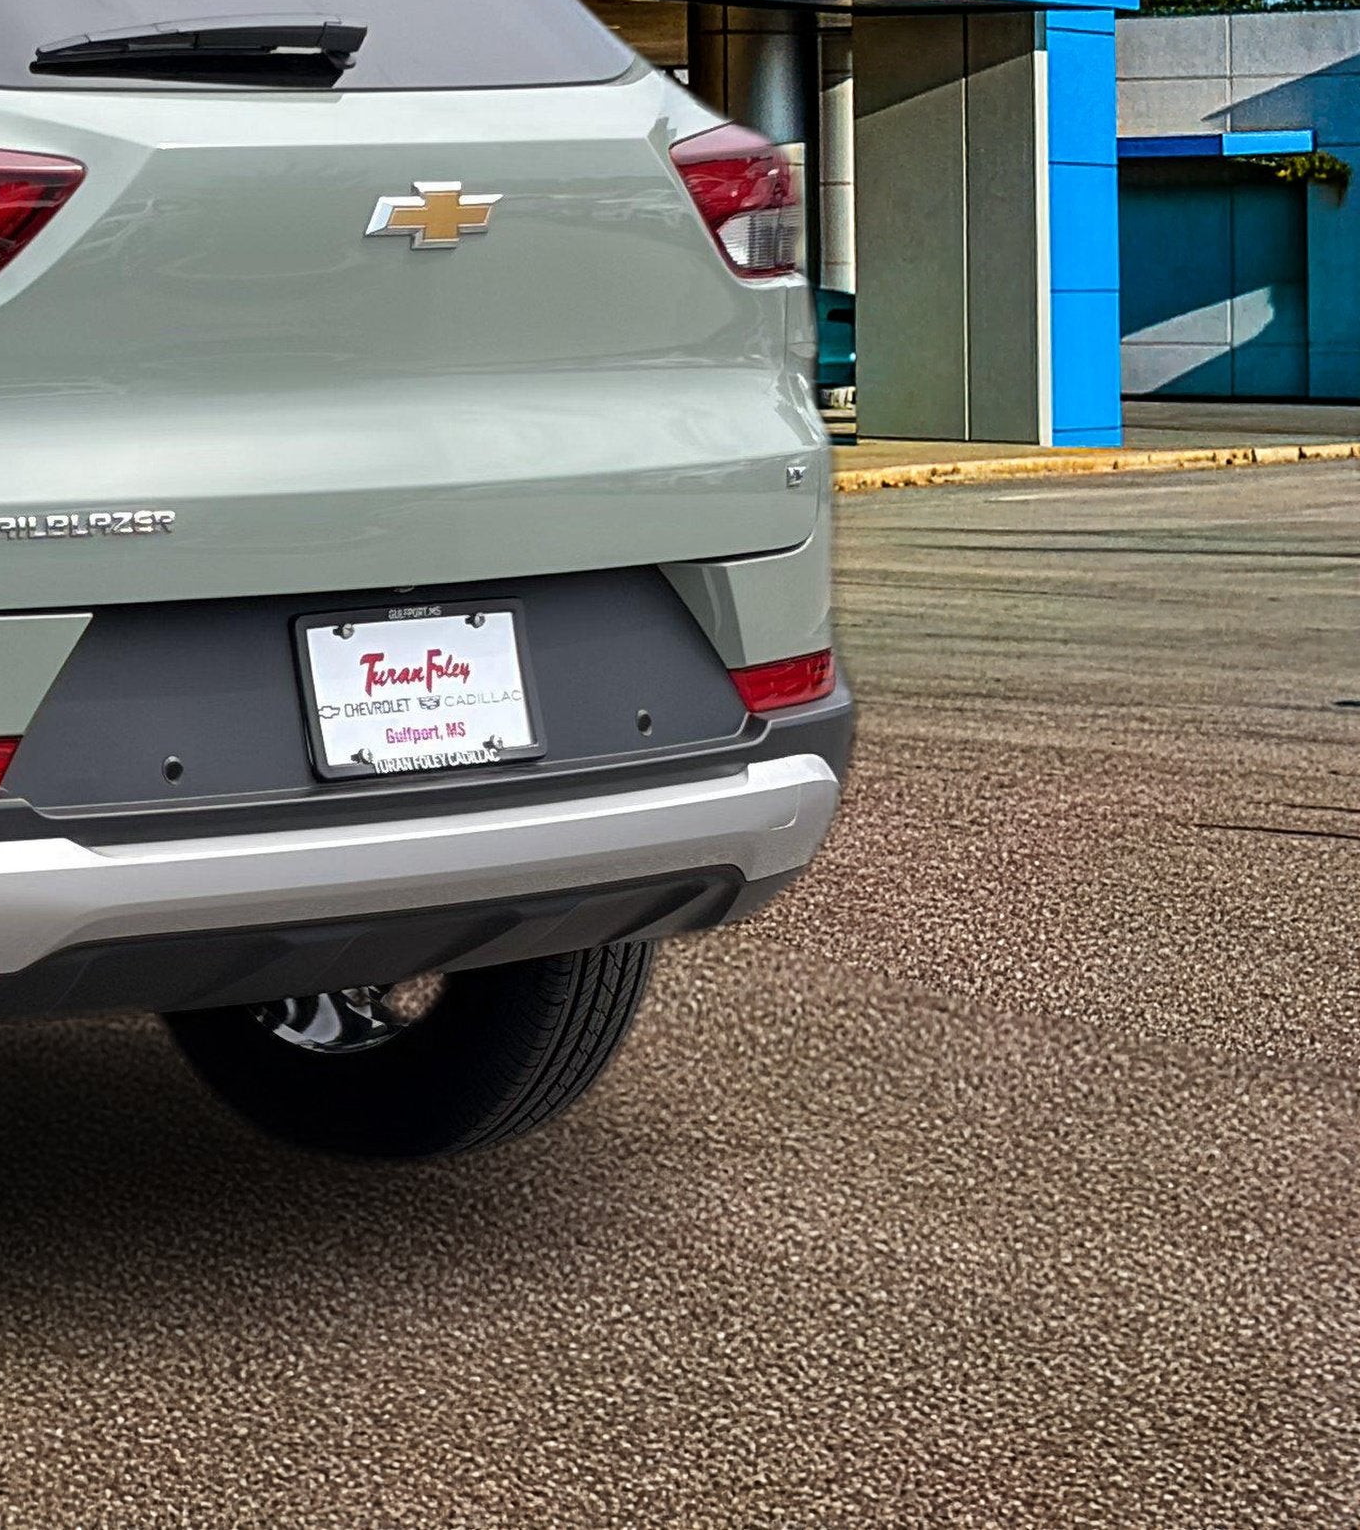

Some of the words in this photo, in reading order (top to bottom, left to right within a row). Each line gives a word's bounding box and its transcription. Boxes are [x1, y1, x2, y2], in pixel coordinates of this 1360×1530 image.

[360, 652, 425, 697] Turan
[425, 648, 471, 693] Foley
[344, 697, 412, 718] CHEVROLET
[444, 689, 523, 707] CADILLAC
[385, 725, 443, 744] Gulfport,
[445, 721, 466, 738] MS
[413, 752, 448, 770] FOLEY
